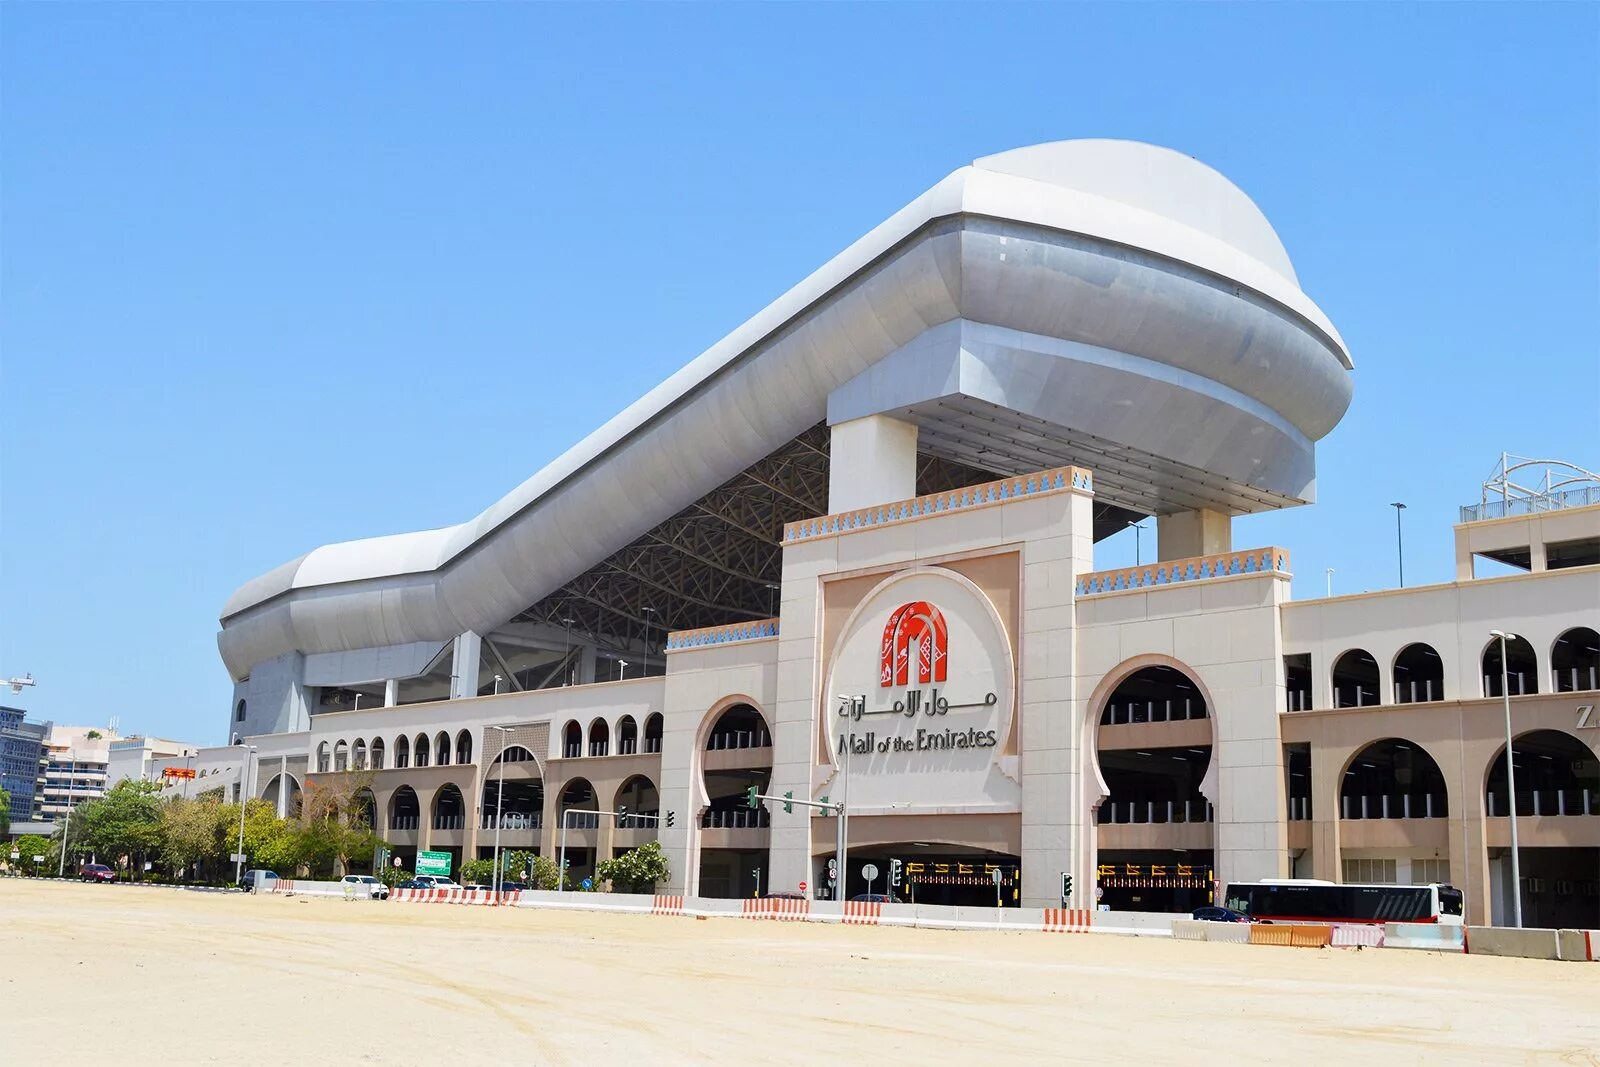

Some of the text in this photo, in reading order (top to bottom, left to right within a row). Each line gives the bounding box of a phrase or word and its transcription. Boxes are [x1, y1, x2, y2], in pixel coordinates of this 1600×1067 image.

[1576, 704, 1600, 729] Z
[838, 727, 997, 755] Mall of the Emirates
